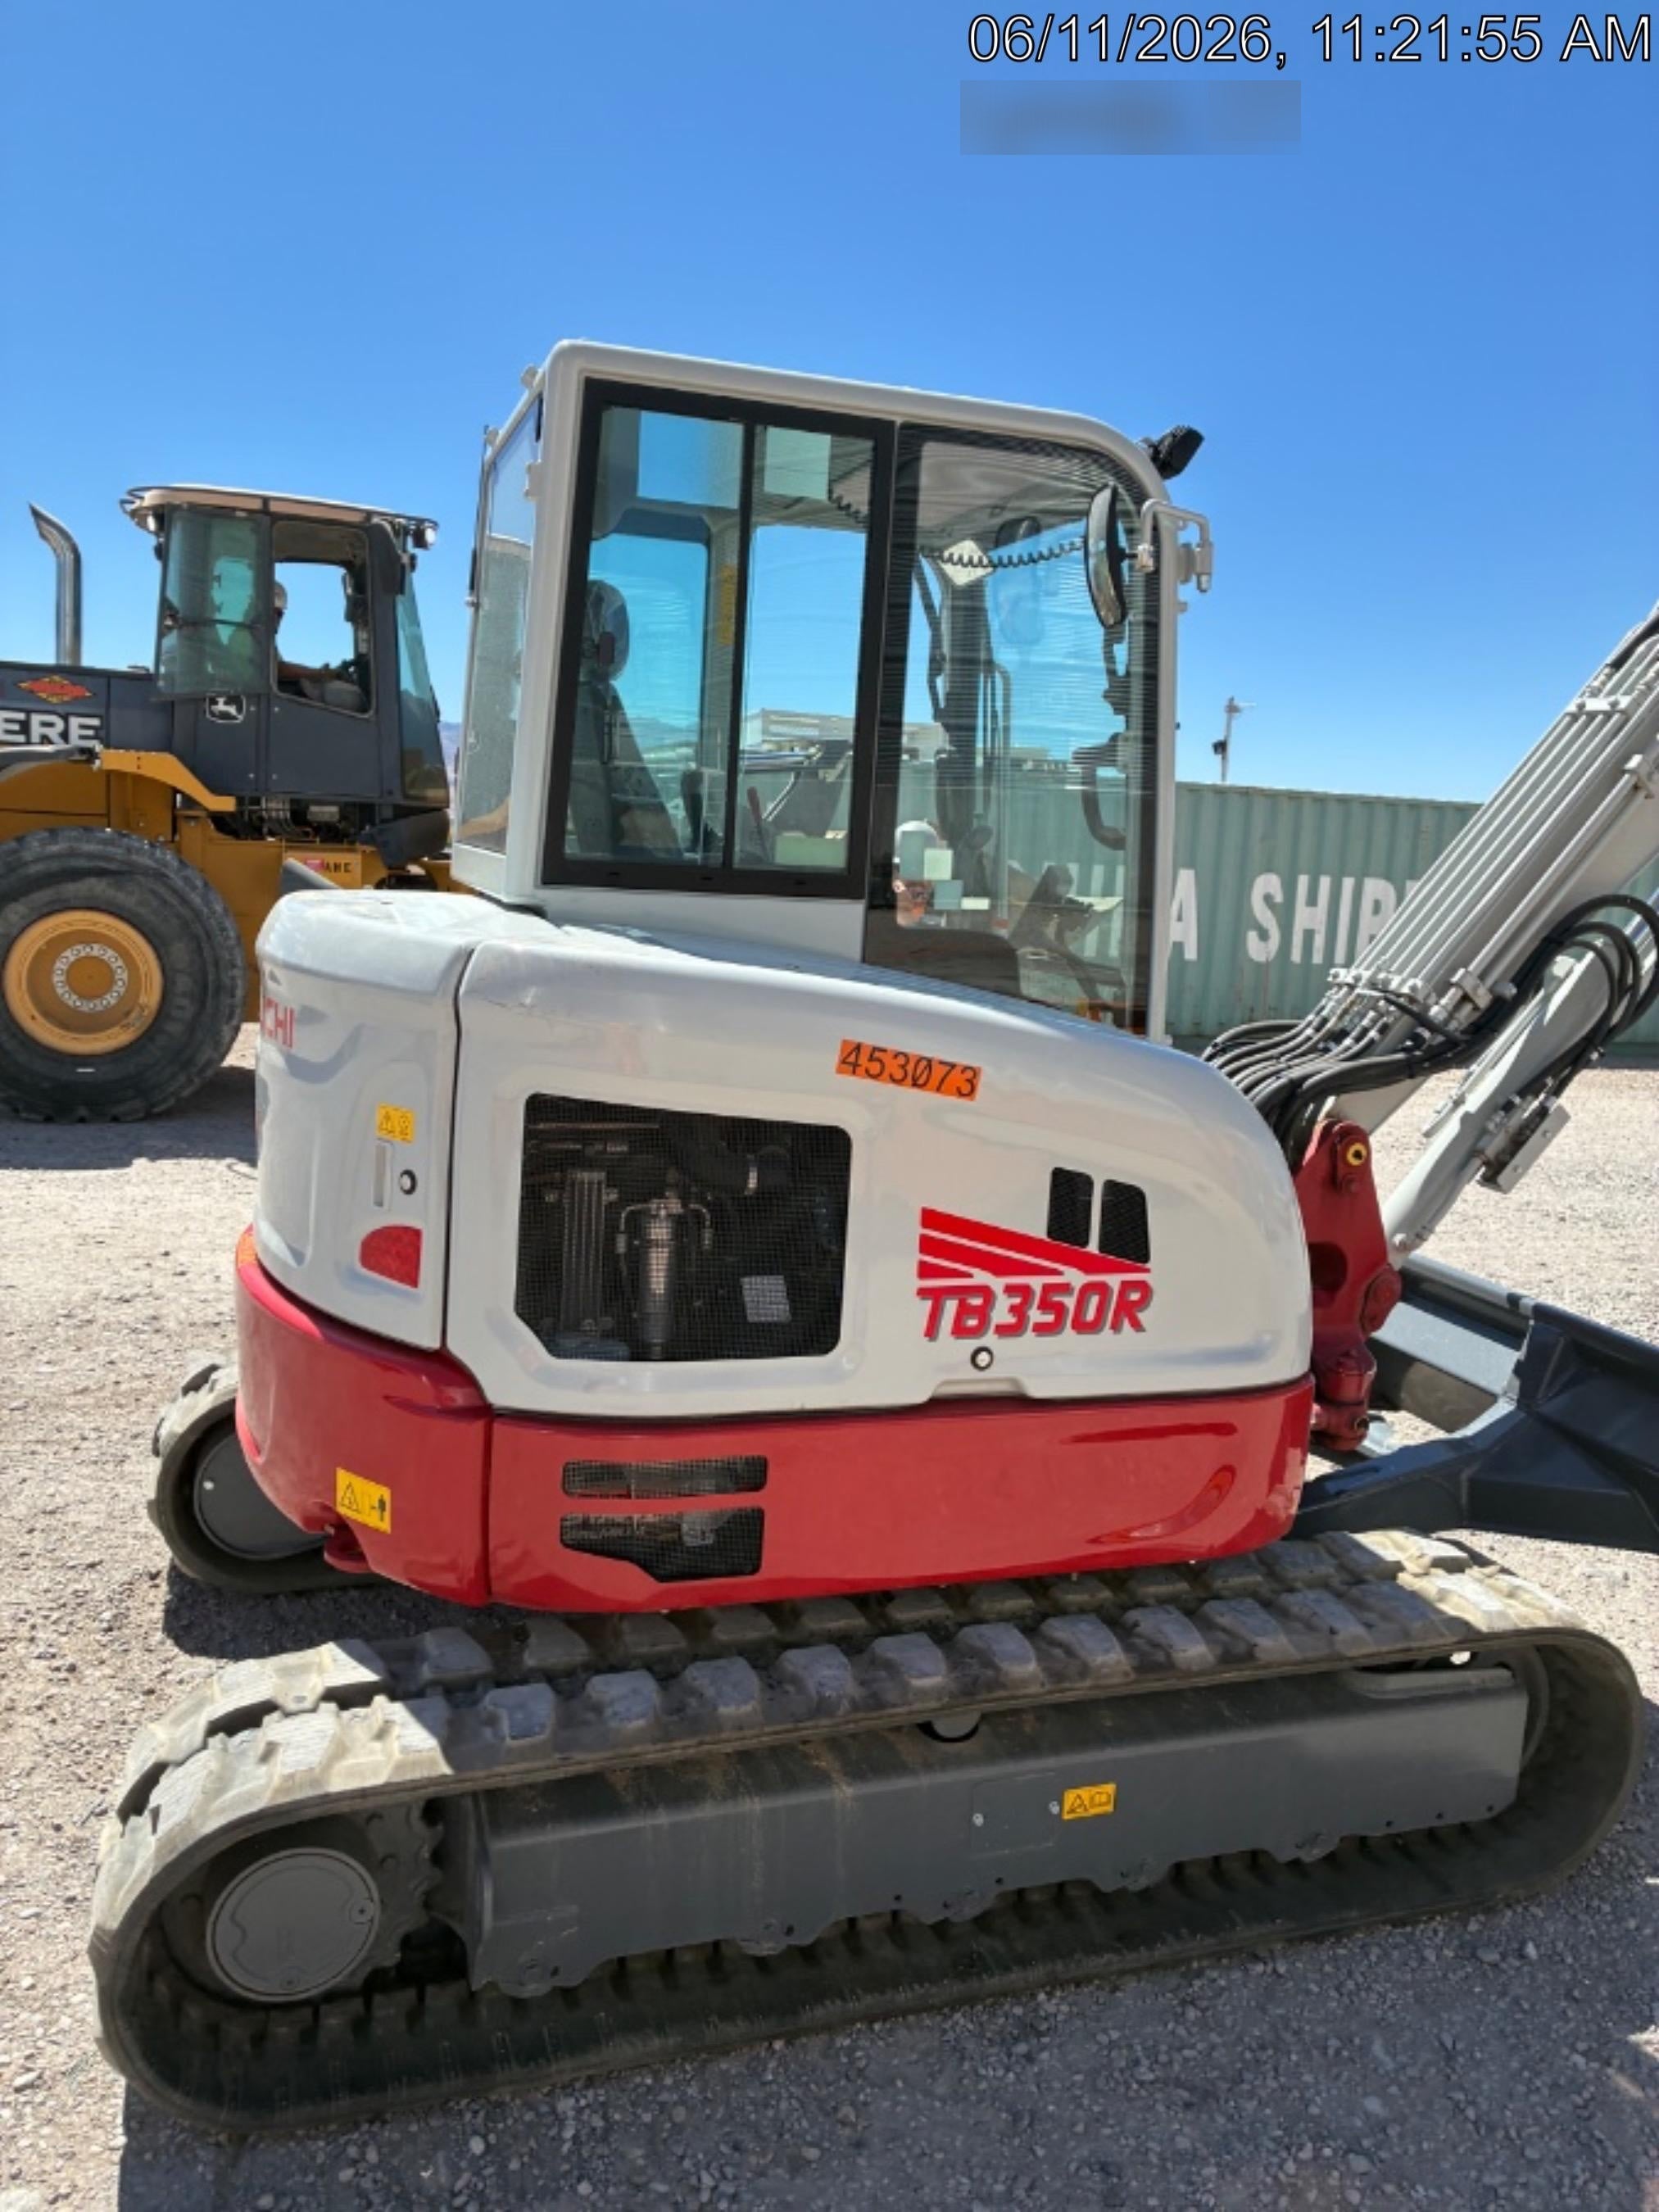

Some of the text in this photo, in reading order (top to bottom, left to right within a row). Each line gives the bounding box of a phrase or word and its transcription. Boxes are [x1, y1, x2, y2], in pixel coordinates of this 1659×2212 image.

[1246, 872, 1420, 965] SHIP
[841, 1041, 977, 1097] 453073
[915, 1280, 1154, 1342] TB350R
